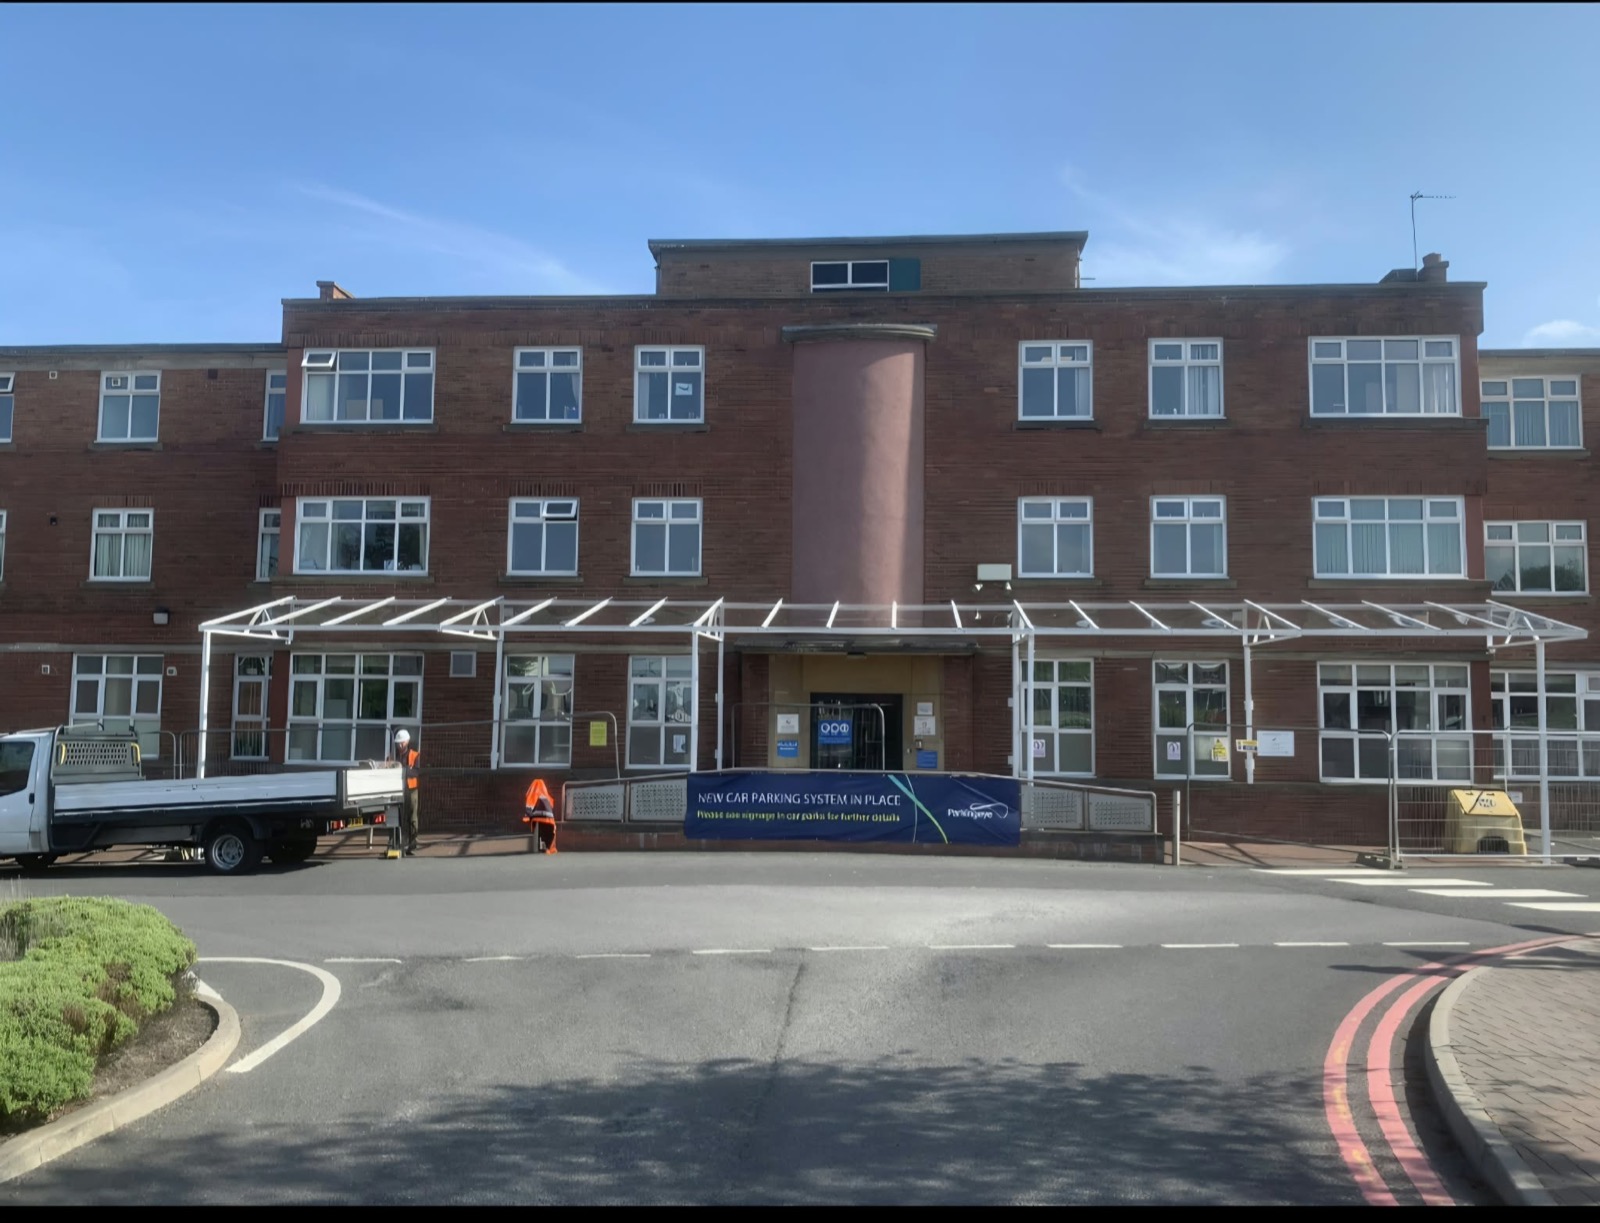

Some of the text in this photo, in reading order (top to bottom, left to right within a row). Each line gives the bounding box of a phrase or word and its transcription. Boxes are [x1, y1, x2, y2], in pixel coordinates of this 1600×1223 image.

[698, 792, 901, 806] NEW CAR PARKING SYSTEM IN PLACE
[786, 812, 801, 821] car
